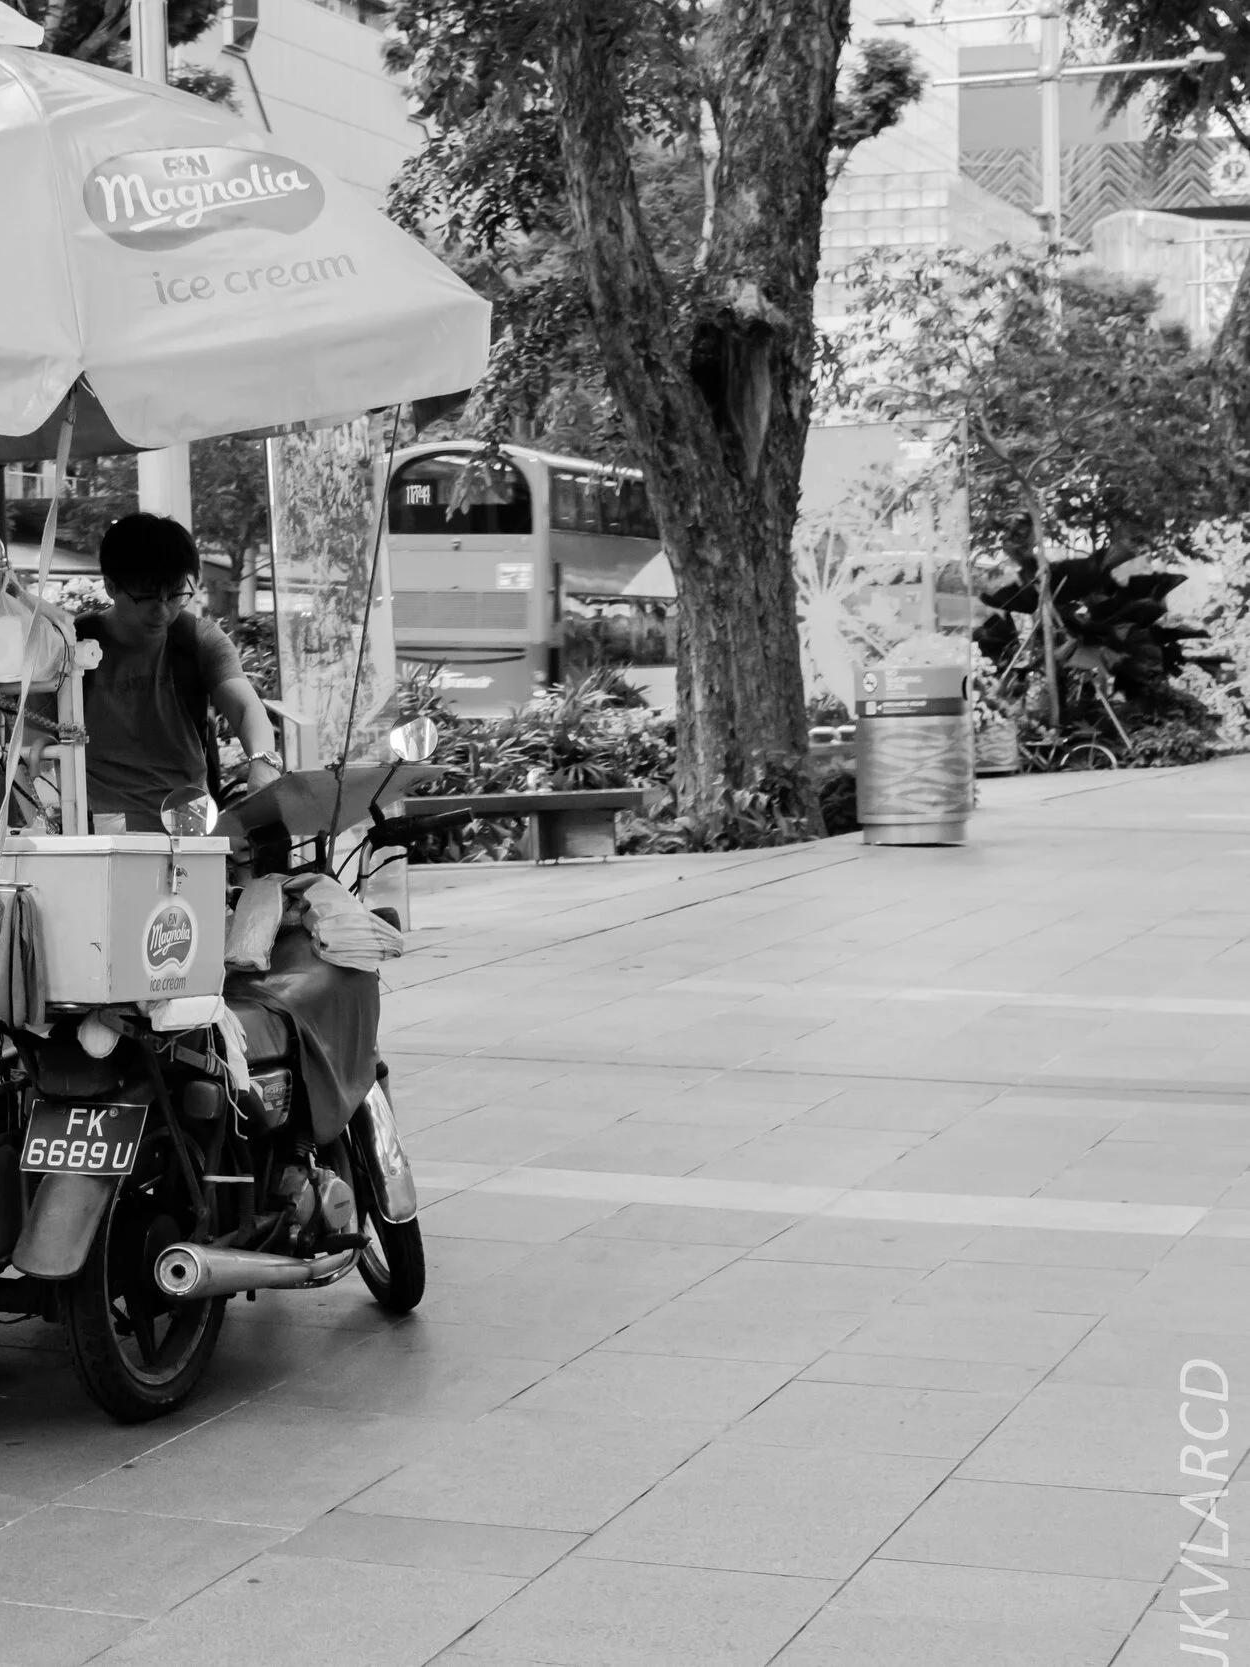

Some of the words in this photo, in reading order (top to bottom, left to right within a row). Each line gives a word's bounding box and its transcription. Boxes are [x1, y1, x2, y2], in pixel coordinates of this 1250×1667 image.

[95, 163, 310, 233] Magnolia
[152, 271, 215, 304] ice
[224, 254, 358, 295] cream
[150, 921, 191, 957] Magnolia
[150, 975, 161, 992] ice
[162, 976, 187, 991] cream
[66, 1108, 108, 1137] FK
